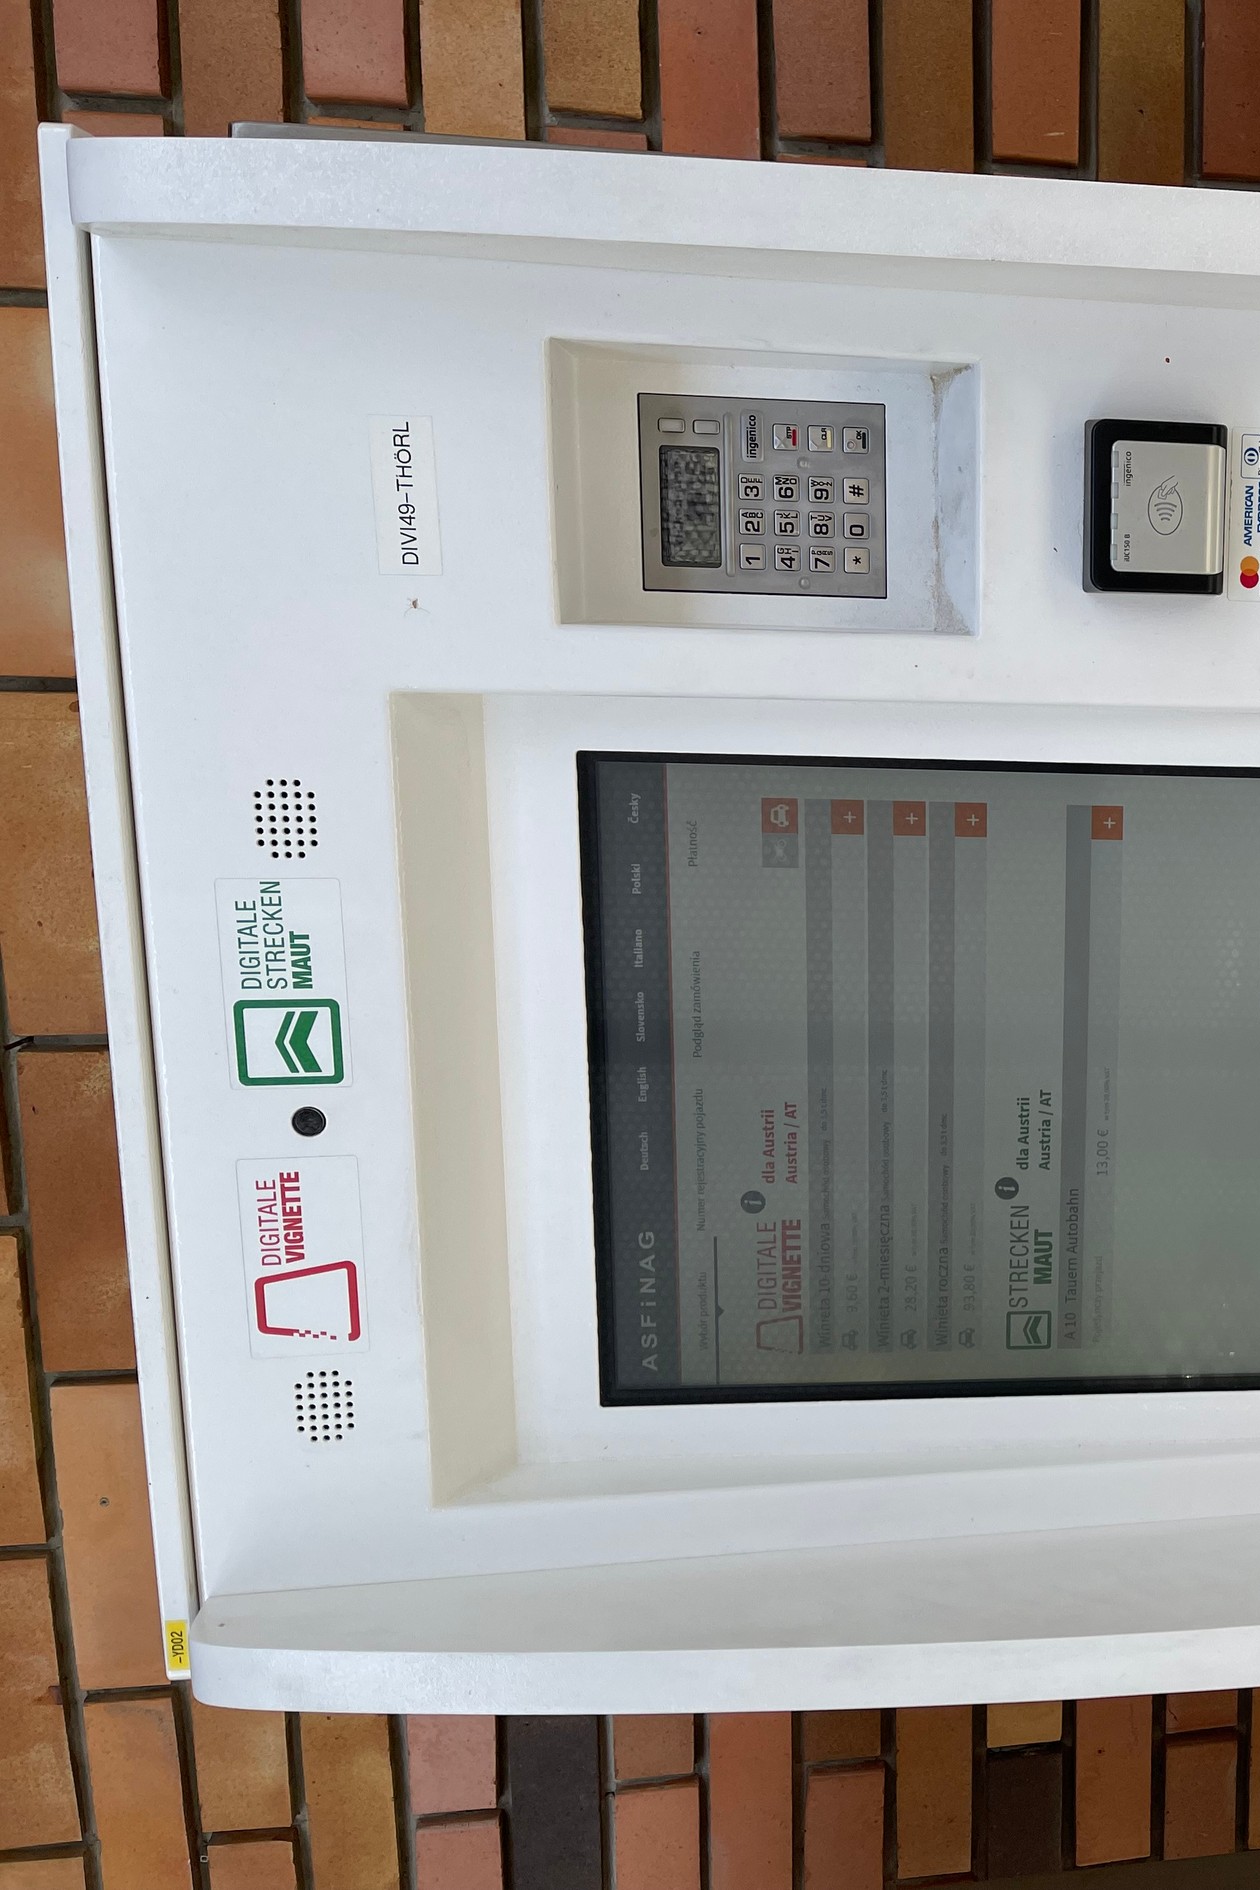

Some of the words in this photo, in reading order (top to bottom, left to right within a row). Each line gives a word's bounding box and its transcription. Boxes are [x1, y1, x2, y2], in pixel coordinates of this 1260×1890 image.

[746, 415, 758, 459] ingenico
[1124, 451, 1133, 486] ingenico
[1244, 485, 1254, 546] AMERICAN
[628, 793, 642, 824] Česky
[687, 820, 699, 867] Płatność
[631, 863, 641, 895] Polski
[235, 900, 261, 990] DIGITALE
[259, 880, 288, 989] STRECKEN
[633, 929, 643, 968] Italiano
[288, 931, 312, 989] MAUT
[690, 951, 701, 1013] zamówienia
[635, 992, 646, 1042] Slovensko
[692, 1016, 704, 1058] Podgląd
[637, 1067, 648, 1102] English
[1040, 1089, 1052, 1107] AT
[693, 1088, 705, 1129] pojazdu
[785, 1101, 797, 1119] AT
[1017, 1097, 1030, 1145] Austrii
[639, 1132, 649, 1170] Deutsch
[762, 1109, 775, 1159] Austrii
[1039, 1119, 1051, 1170] Austria
[1097, 1129, 1108, 1137] €
[694, 1132, 706, 1195] rejestracyjny
[763, 1161, 775, 1184] dla
[785, 1132, 797, 1184] Austria
[1016, 1148, 1029, 1170] dla
[1096, 1141, 1111, 1176] 13,00
[255, 1179, 282, 1266] DIGITALE
[279, 1171, 305, 1264] VIGNETTE
[695, 1198, 705, 1231] Numer
[1066, 1189, 1079, 1254] Autobahn
[757, 1222, 777, 1310] DIGITALE
[782, 1219, 801, 1312] VIGNETTE
[818, 1223, 831, 1294] 10-dniowa
[877, 1205, 892, 1293] 2-miesięczna
[906, 1264, 916, 1274] €
[938, 1247, 948, 1292] roczna
[964, 1264, 975, 1272] €
[1009, 1205, 1030, 1308] STRECKEN
[1034, 1229, 1052, 1285] MAUT
[697, 1272, 709, 1316] produktu
[846, 1273, 858, 1281] €
[905, 1276, 919, 1312] 28,20
[964, 1275, 977, 1312] 93,80
[1065, 1258, 1078, 1303] Tauern
[819, 1297, 831, 1348] Winieta
[878, 1297, 890, 1347] Winieta
[936, 1296, 948, 1346] Winieta
[1065, 1313, 1076, 1327] 10
[1065, 1330, 1076, 1340] A
